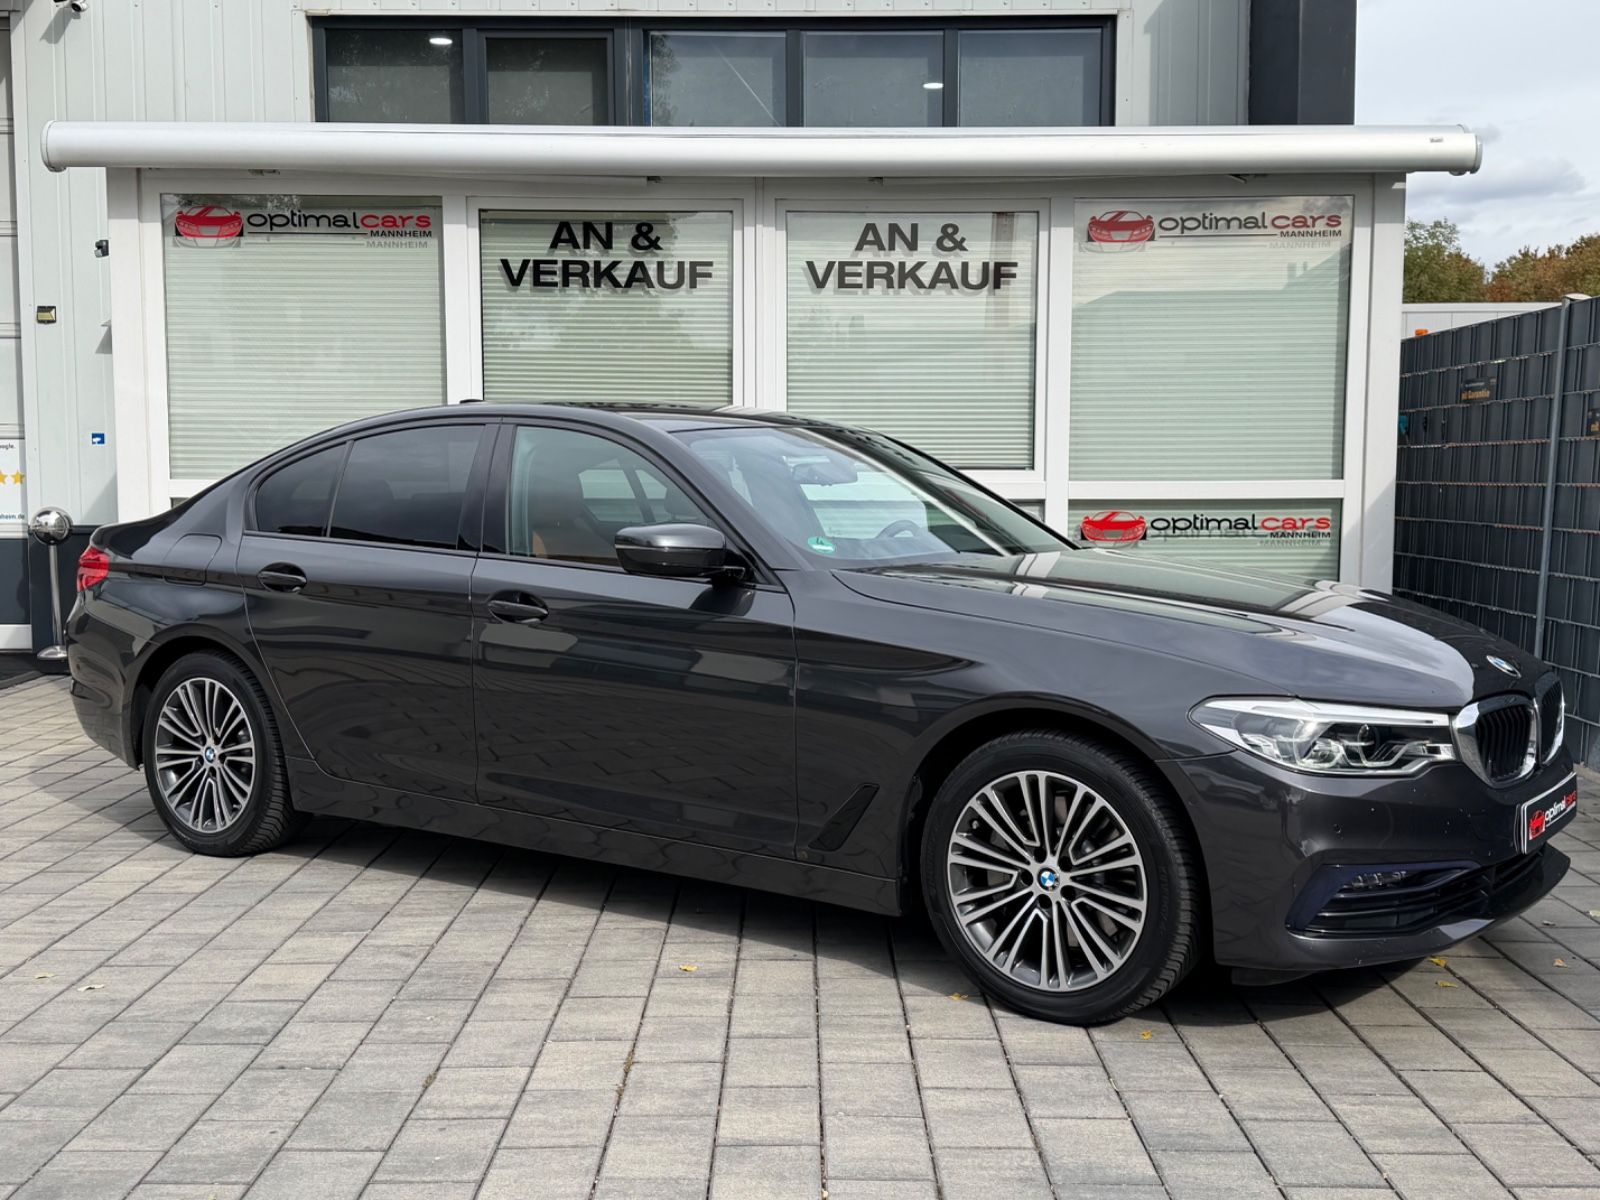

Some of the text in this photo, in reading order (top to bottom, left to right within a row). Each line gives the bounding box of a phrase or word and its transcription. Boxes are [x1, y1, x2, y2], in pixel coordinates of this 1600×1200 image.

[247, 209, 432, 231] optimalcars
[370, 230, 432, 238] MANNHEIM
[549, 221, 664, 251] AN &
[854, 222, 969, 252] AN &
[1279, 229, 1342, 238] MANNHEIM
[500, 258, 714, 290] VERKAUF
[805, 260, 1019, 290] VERKAUF
[1150, 513, 1332, 533] optimalcars
[1270, 531, 1331, 539] MANNHEIM
